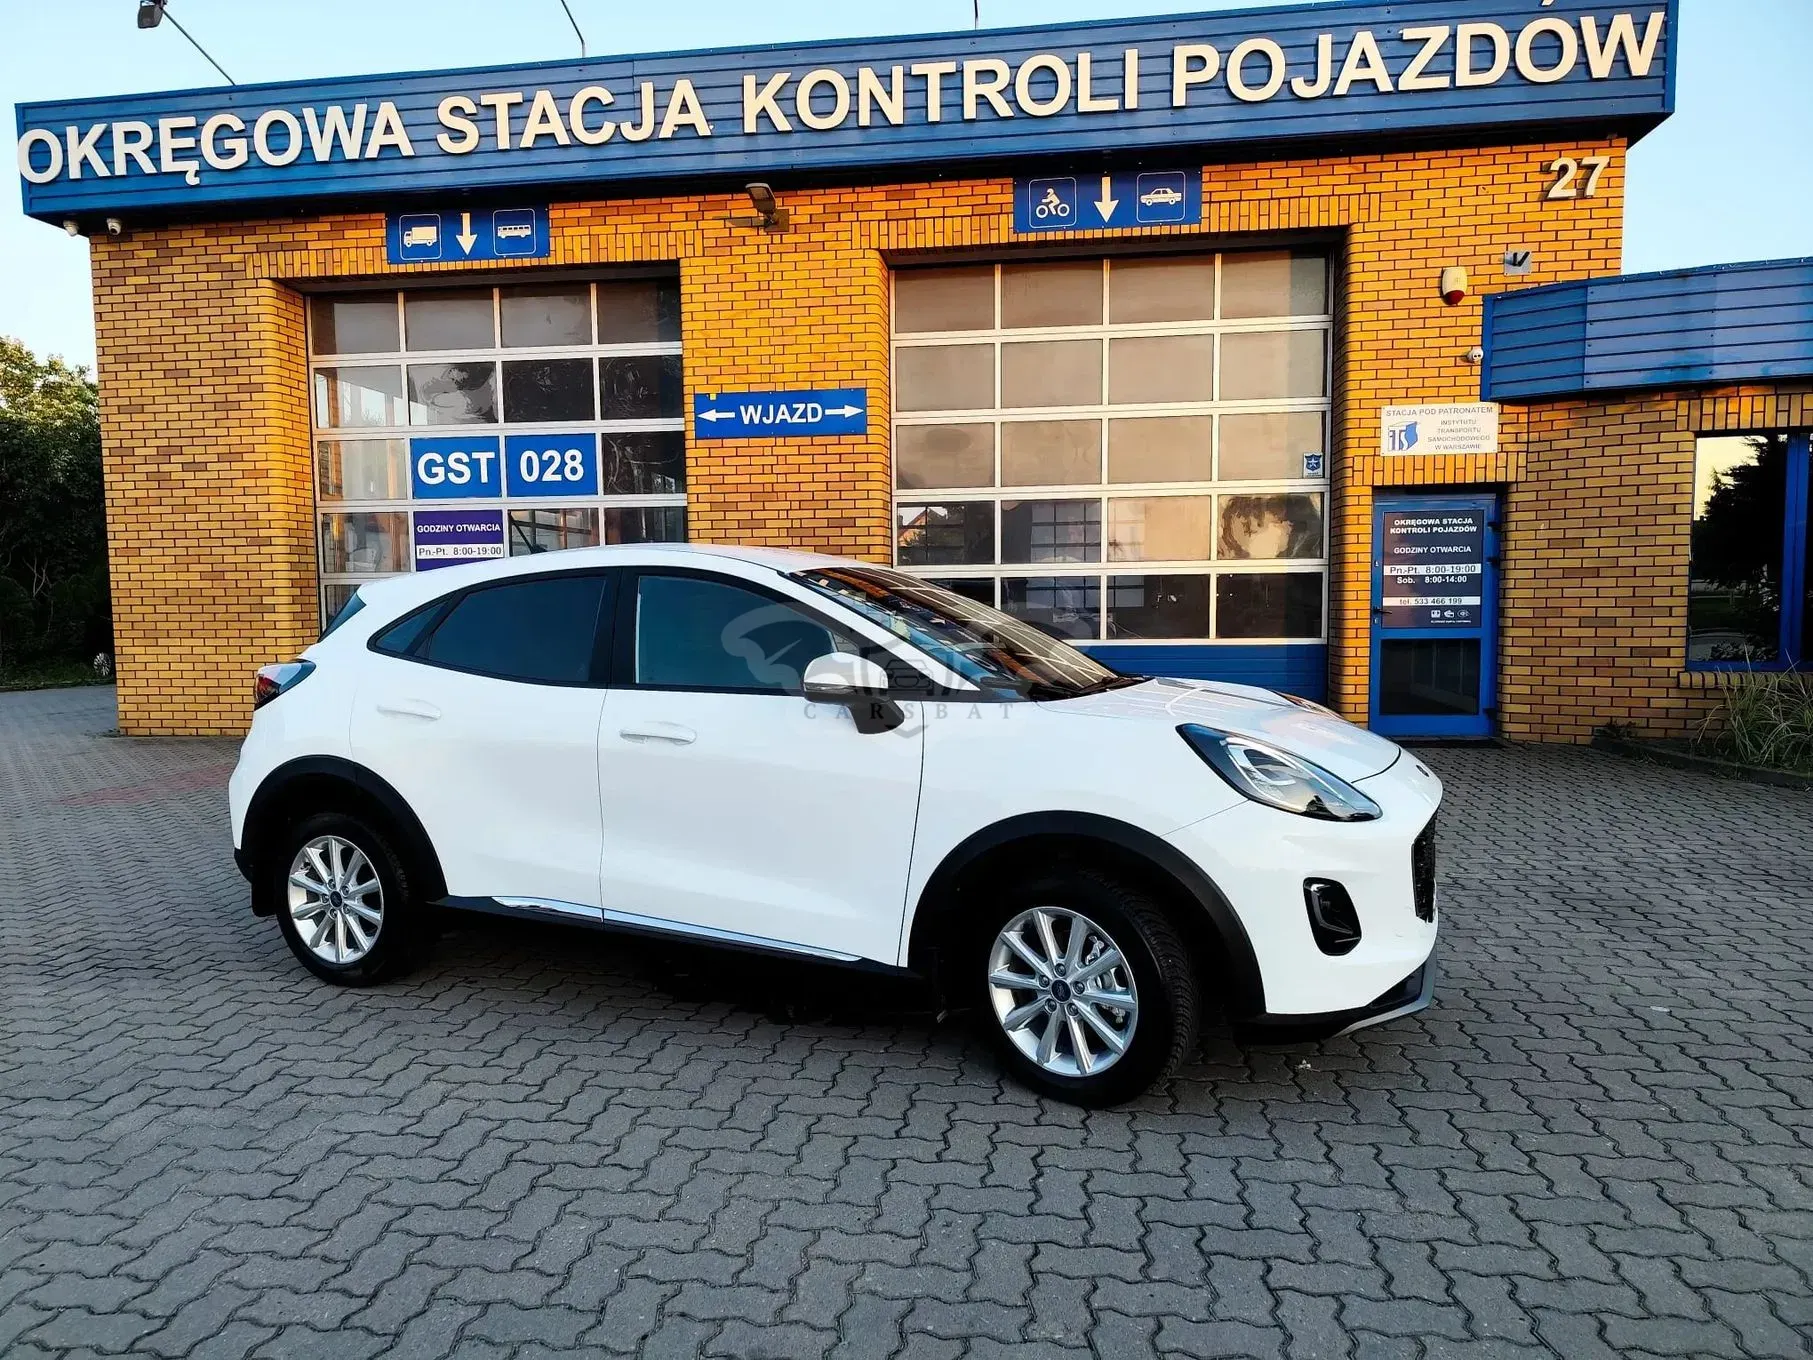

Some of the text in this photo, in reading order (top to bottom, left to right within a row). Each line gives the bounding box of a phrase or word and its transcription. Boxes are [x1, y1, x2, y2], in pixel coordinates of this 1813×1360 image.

[17, 0, 1666, 186] OKRĘGOWA STACJA KONTROLI POJAZDÓW
[1546, 156, 1610, 200] 27
[740, 403, 823, 425] WJAZD
[1386, 409, 1417, 417] STACJA
[1438, 406, 1493, 415] PATRONATEM
[417, 448, 584, 485] GST 028
[1394, 517, 1473, 526] OKRĘGOWA STACJA
[416, 523, 501, 533] GODZINY OTWARCIA
[1390, 525, 1477, 534] KONTROLI POJAZDÓW
[418, 546, 502, 557] Pn.-Pt. 8:00-19:00
[1394, 546, 1428, 554] GODZINY
[1425, 565, 1476, 574] 8:00-19:00
[1397, 575, 1467, 584] Sob. 8:00-14:00
